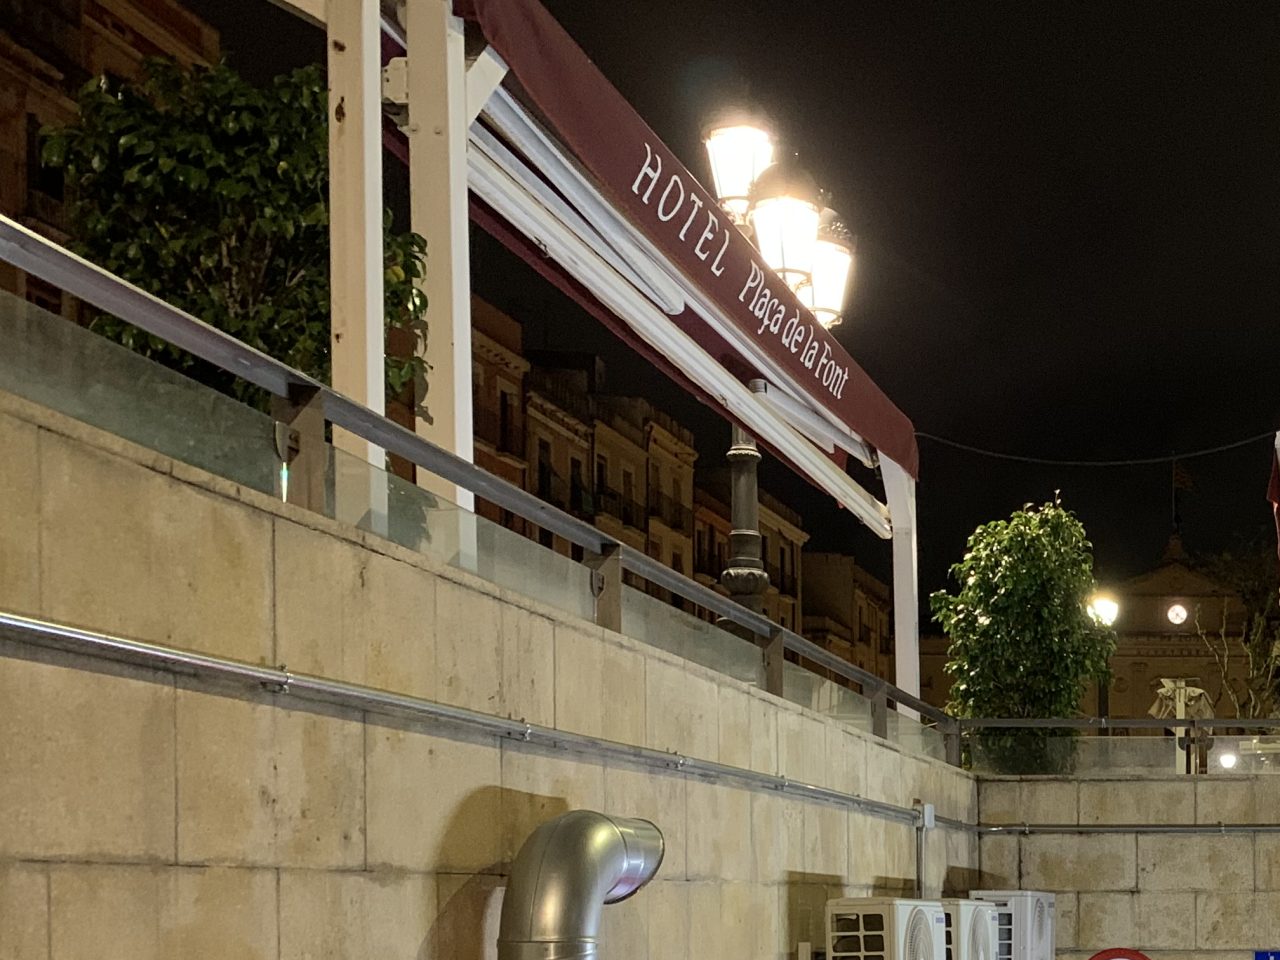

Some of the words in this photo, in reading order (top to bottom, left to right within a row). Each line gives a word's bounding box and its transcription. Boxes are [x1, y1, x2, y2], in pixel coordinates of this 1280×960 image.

[631, 142, 732, 278] HOTEL
[737, 258, 788, 335] Plaça
[781, 308, 806, 353] de
[803, 324, 820, 370] la
[814, 340, 851, 400] Font
